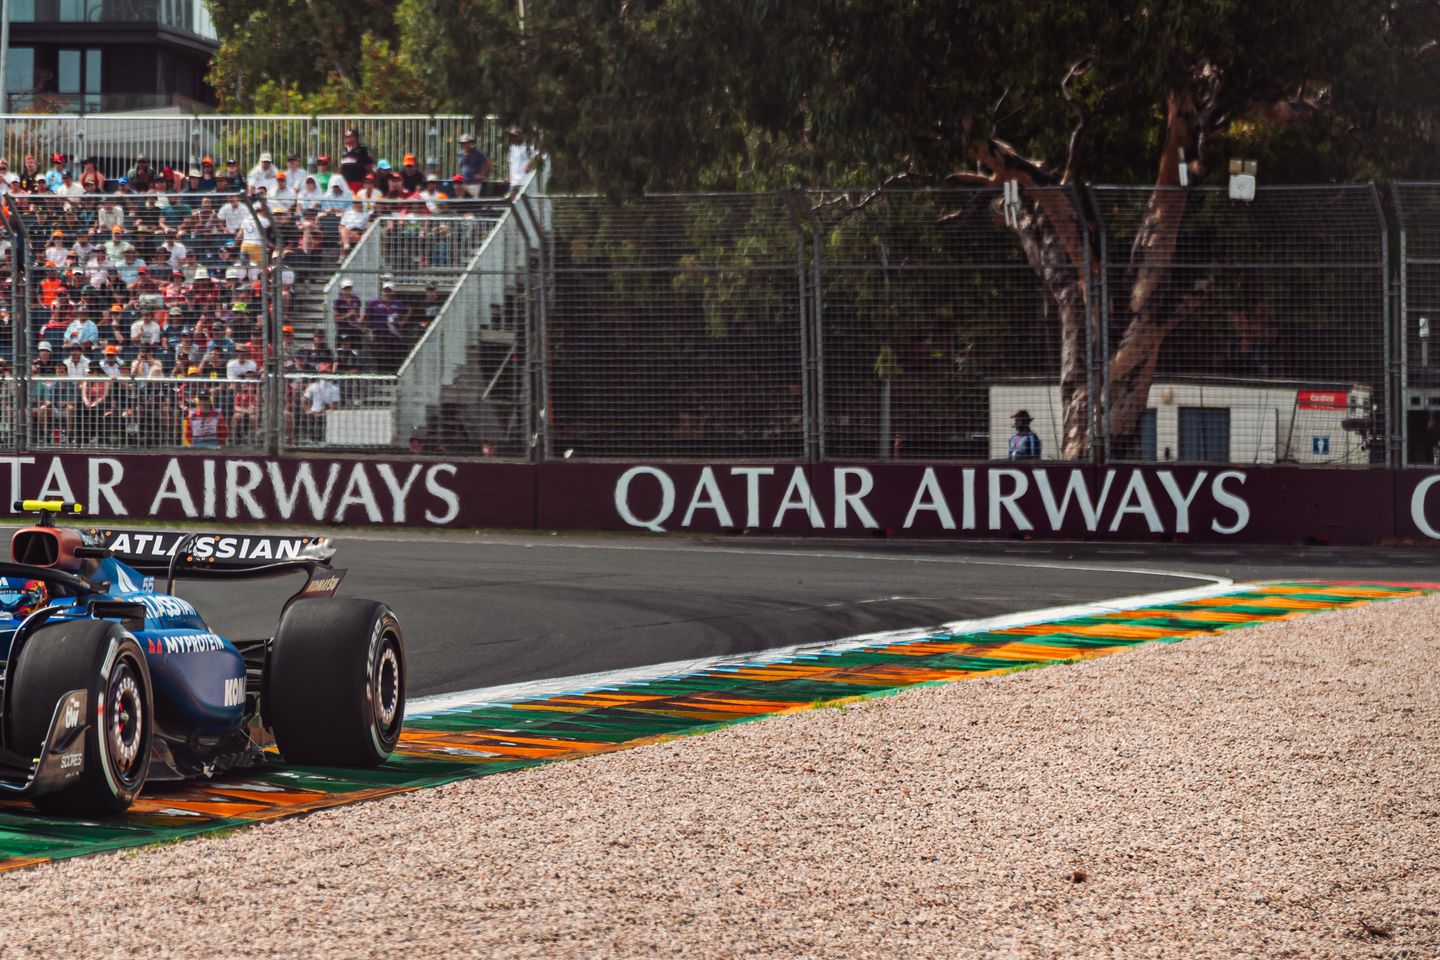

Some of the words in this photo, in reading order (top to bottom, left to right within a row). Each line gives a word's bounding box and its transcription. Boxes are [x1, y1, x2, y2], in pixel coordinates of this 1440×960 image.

[149, 457, 460, 525] AIRWAYS
[614, 466, 880, 532] QATAR
[902, 467, 1250, 534] AIRWAYS
[142, 576, 155, 593] 55
[163, 633, 225, 654] MYPROTEIN
